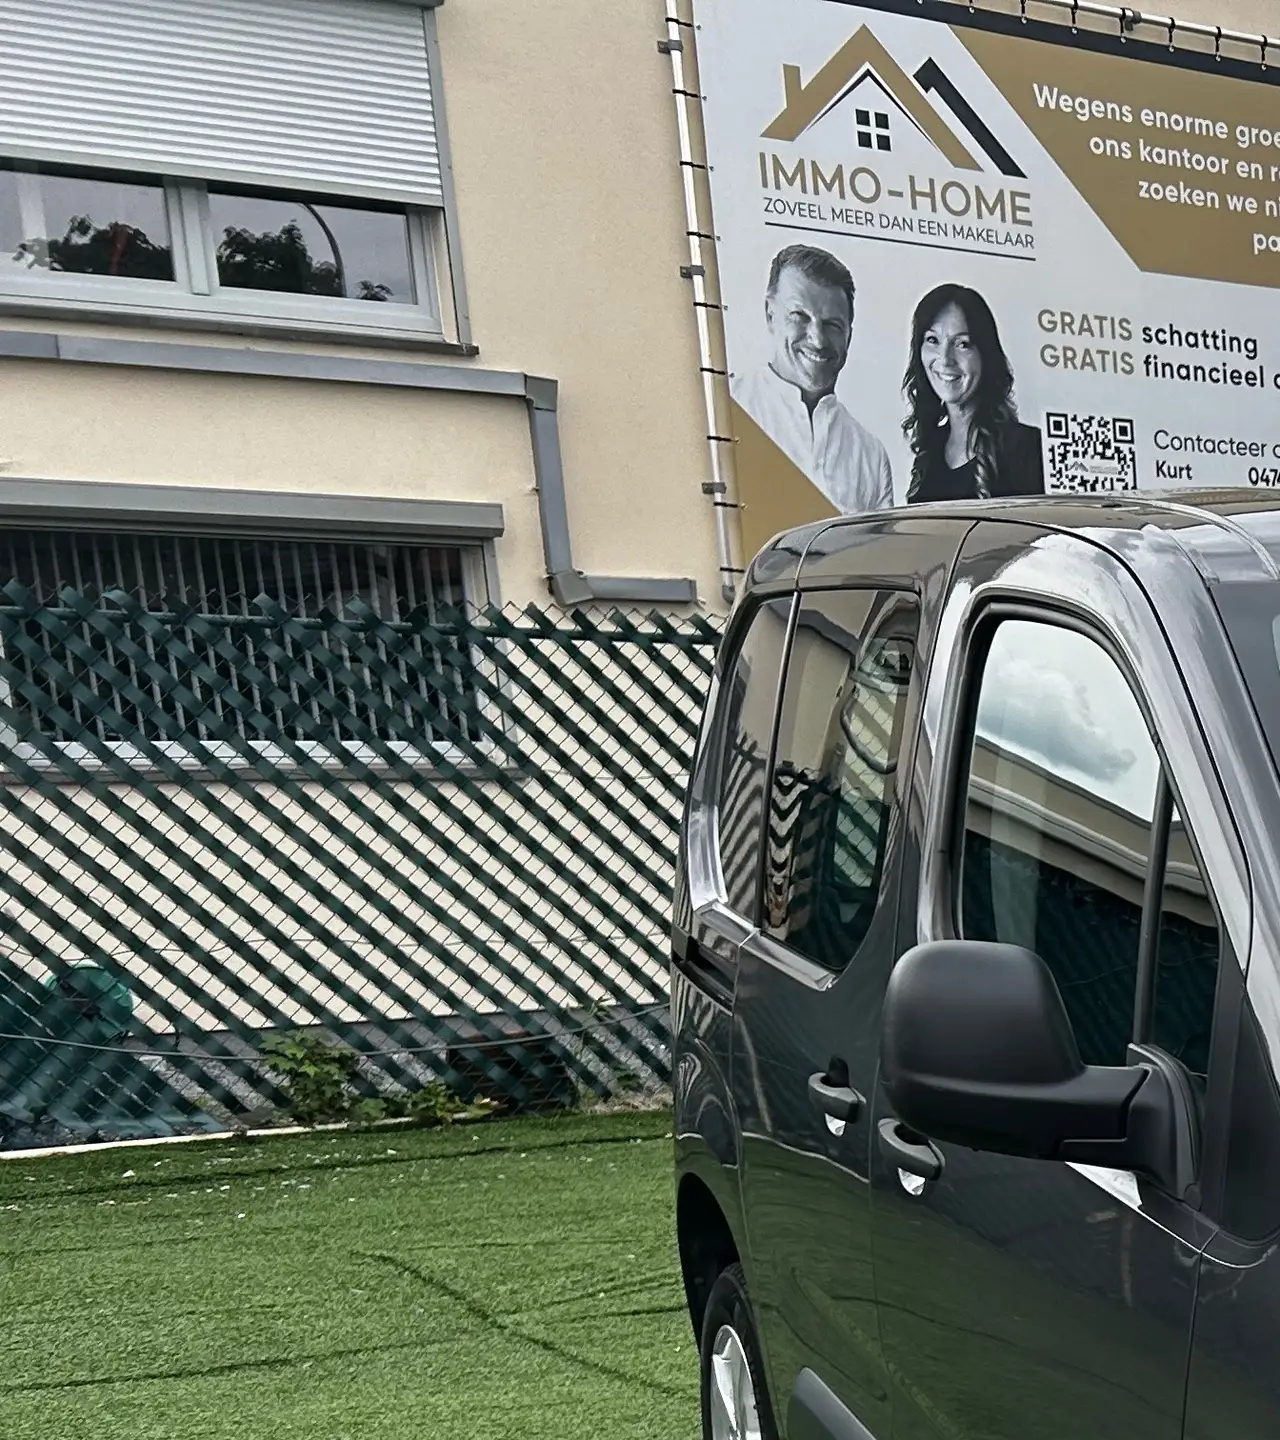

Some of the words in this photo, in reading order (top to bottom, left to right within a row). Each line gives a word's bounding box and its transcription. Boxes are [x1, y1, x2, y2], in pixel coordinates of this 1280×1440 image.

[1033, 83, 1133, 121] Wegens
[1141, 108, 1228, 139] enorme
[1089, 136, 1131, 159] ons
[1139, 138, 1229, 174] kantoor
[1236, 160, 1263, 180] en
[759, 152, 1033, 227] IMMO-HOME
[1138, 180, 1219, 209] zoeken
[1226, 193, 1257, 215] we
[763, 197, 827, 221] ZOVEEL
[831, 207, 874, 227] MEER
[879, 213, 914, 233] DAN
[918, 218, 948, 238] EEN
[952, 224, 1034, 249] MAKELAAR
[1037, 309, 1133, 342] GRATIS
[1142, 323, 1258, 360] schatting
[1039, 344, 1135, 376] GRATIS
[1143, 354, 1264, 389] financieel
[1153, 429, 1267, 458] Contacteer
[1156, 459, 1193, 481] Kurt
